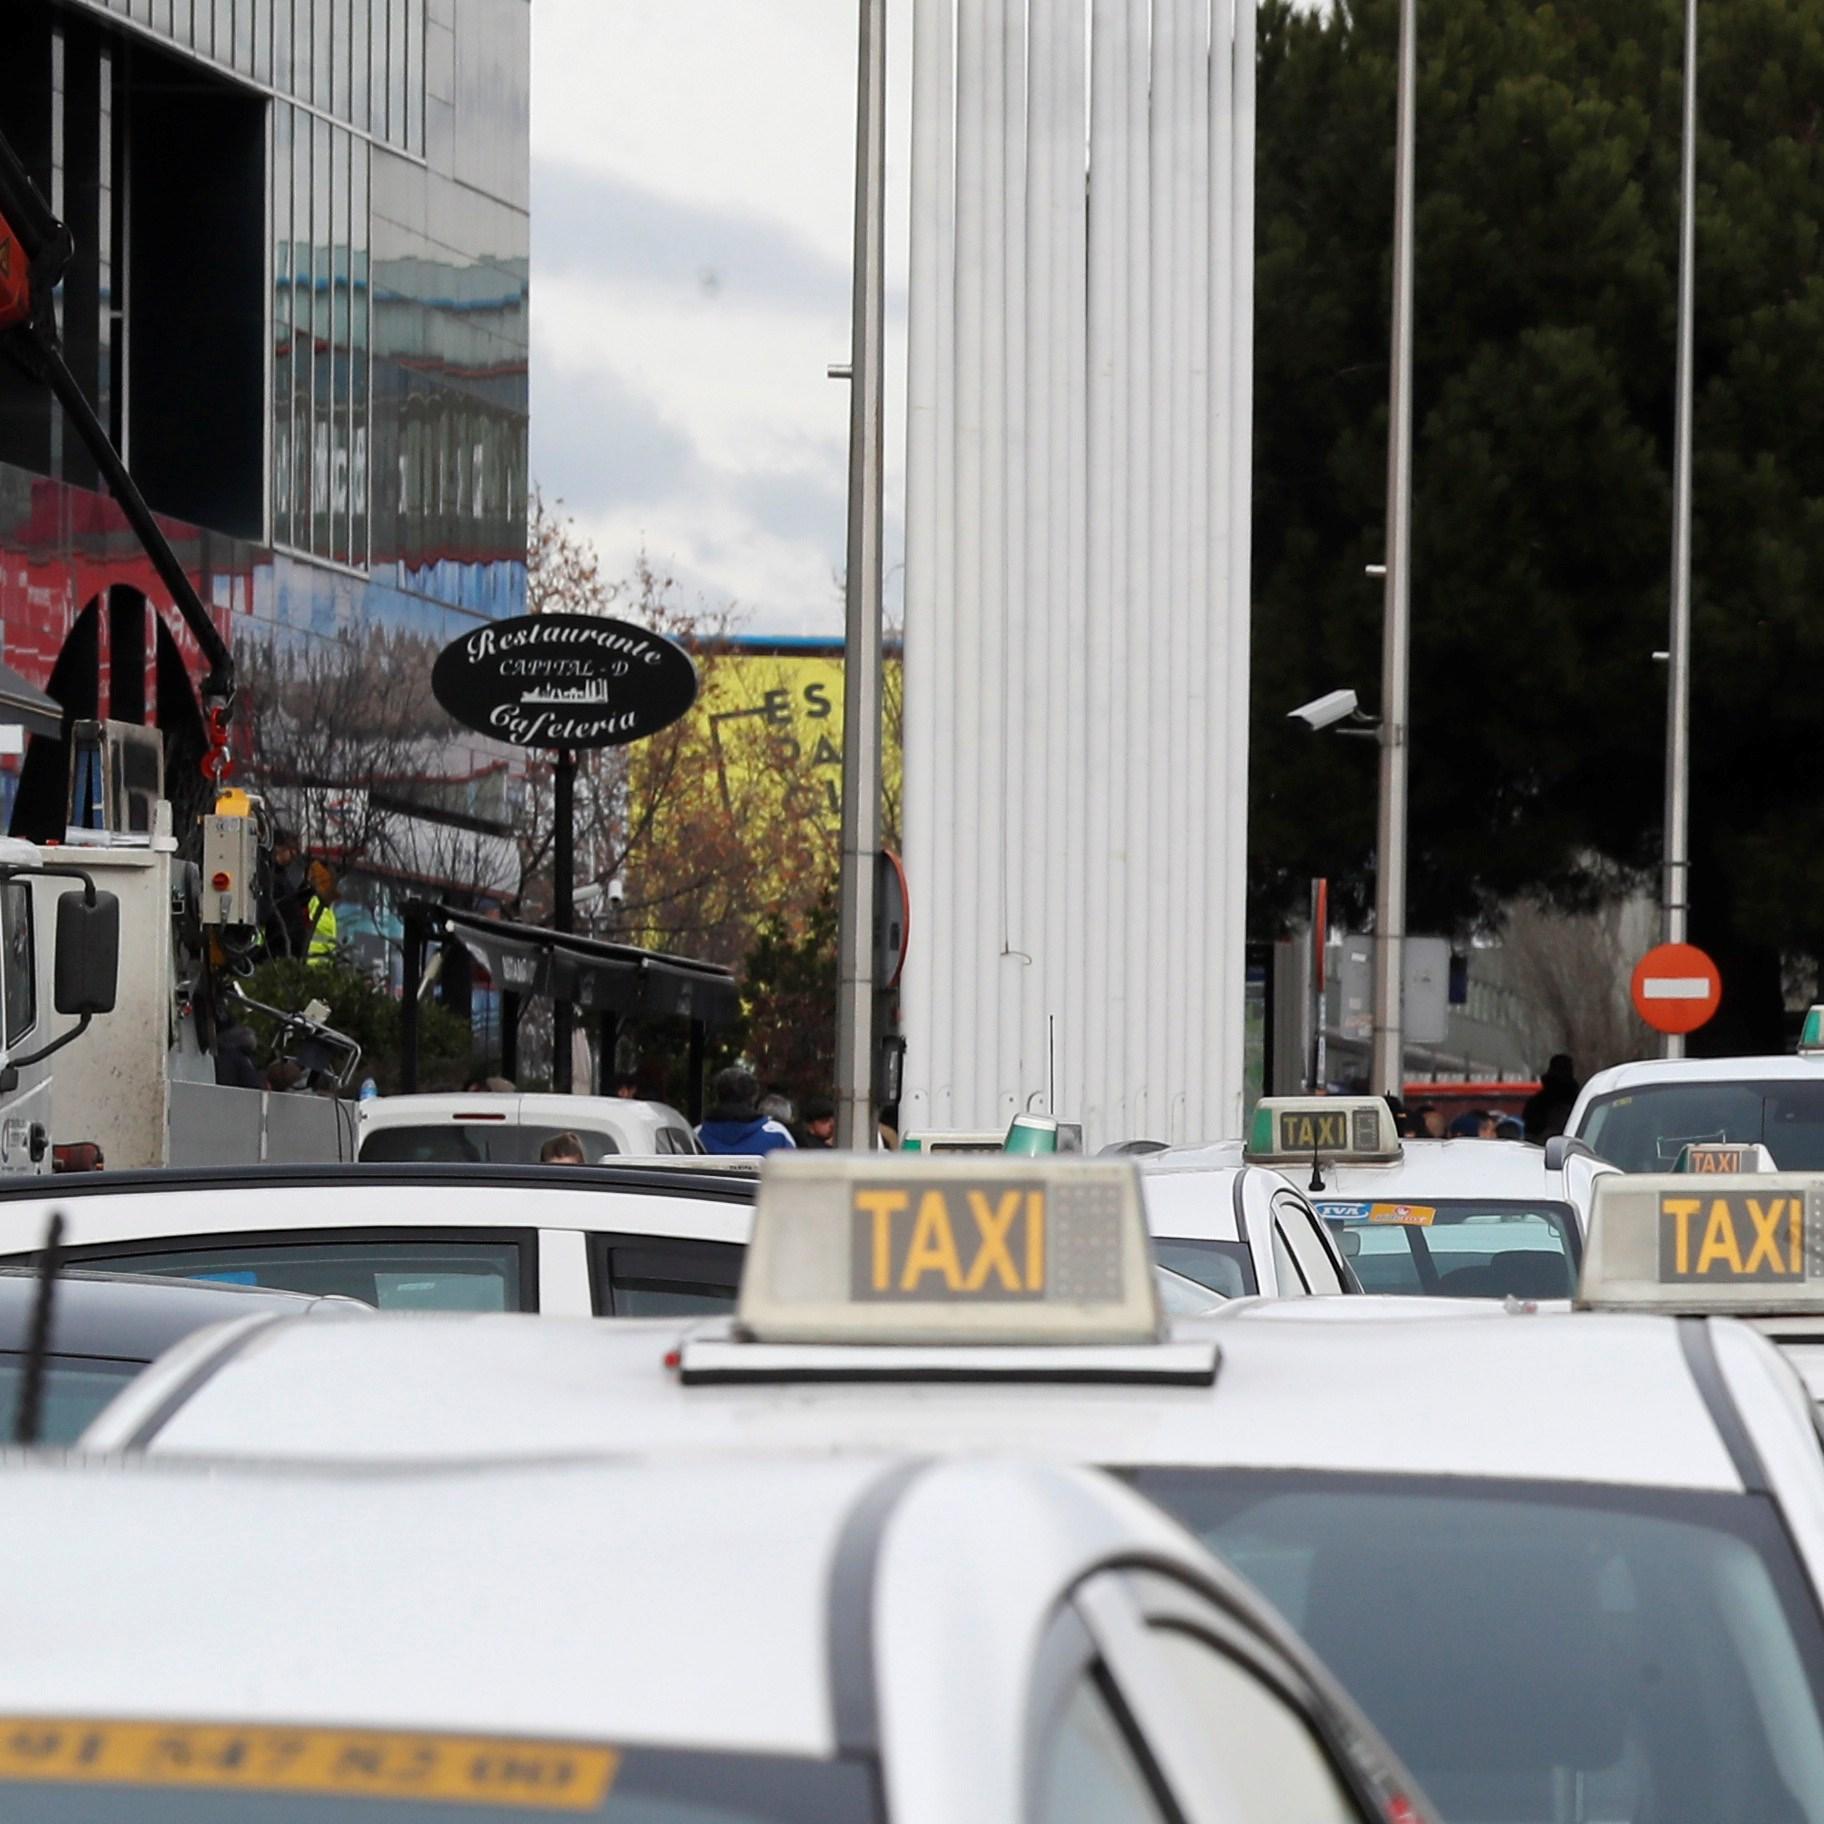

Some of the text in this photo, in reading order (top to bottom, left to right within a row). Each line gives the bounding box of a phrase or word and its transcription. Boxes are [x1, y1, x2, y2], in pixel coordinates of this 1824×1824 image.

[467, 623, 662, 665] Restaurante
[499, 659, 595, 677] CAPITAL
[611, 660, 629, 677] D
[1283, 1116, 1346, 1147] TAXI
[1692, 1151, 1741, 1173] TAXI
[855, 1189, 1045, 1293] TAXI
[1662, 1198, 1801, 1275] TAXI
